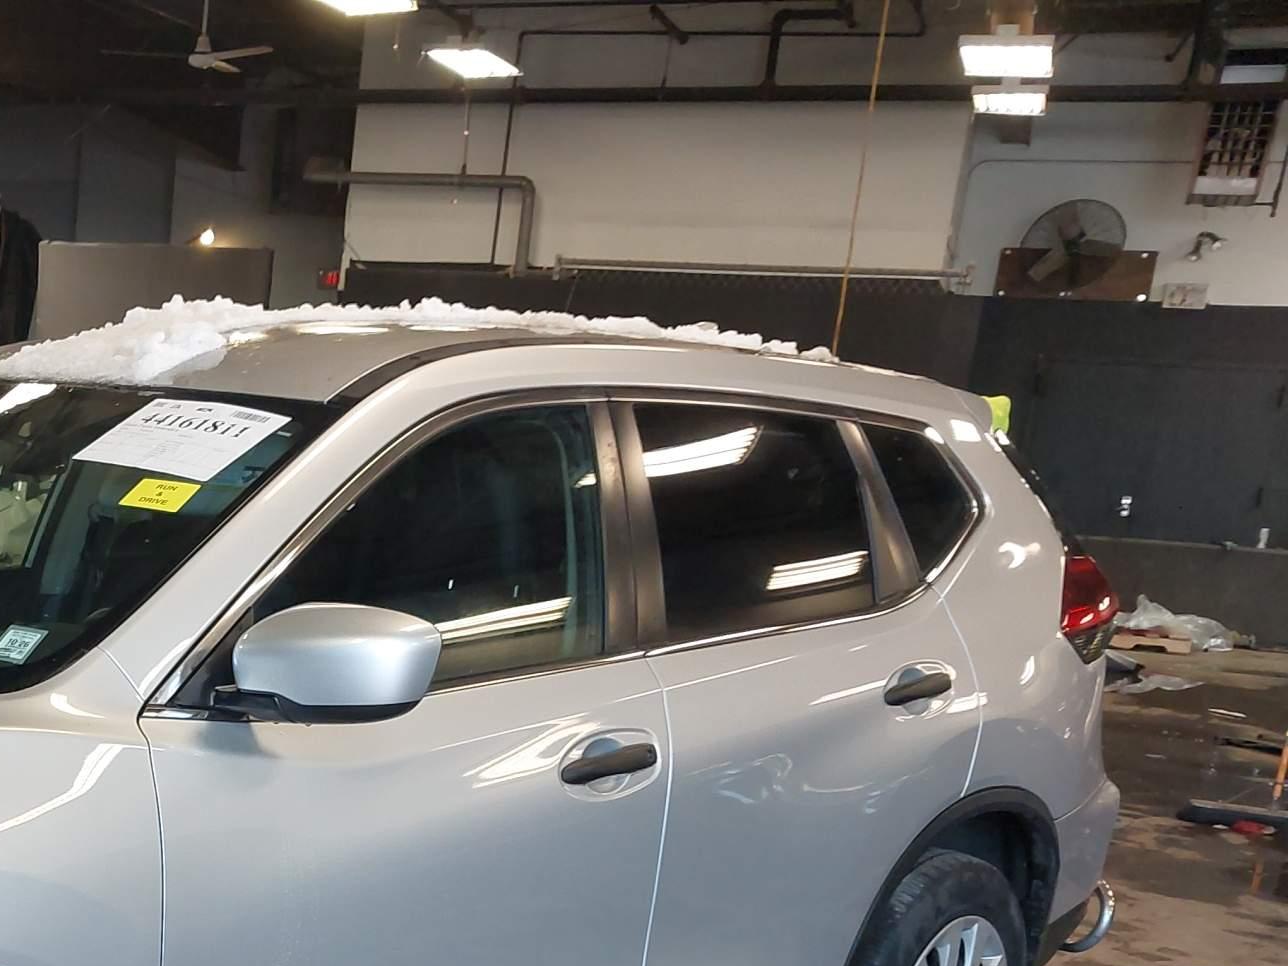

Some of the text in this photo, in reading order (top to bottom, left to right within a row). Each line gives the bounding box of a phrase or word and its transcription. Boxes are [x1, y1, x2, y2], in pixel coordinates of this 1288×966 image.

[141, 412, 251, 438] 44161811
[155, 484, 179, 492] RUN
[138, 496, 169, 506] DRIVE
